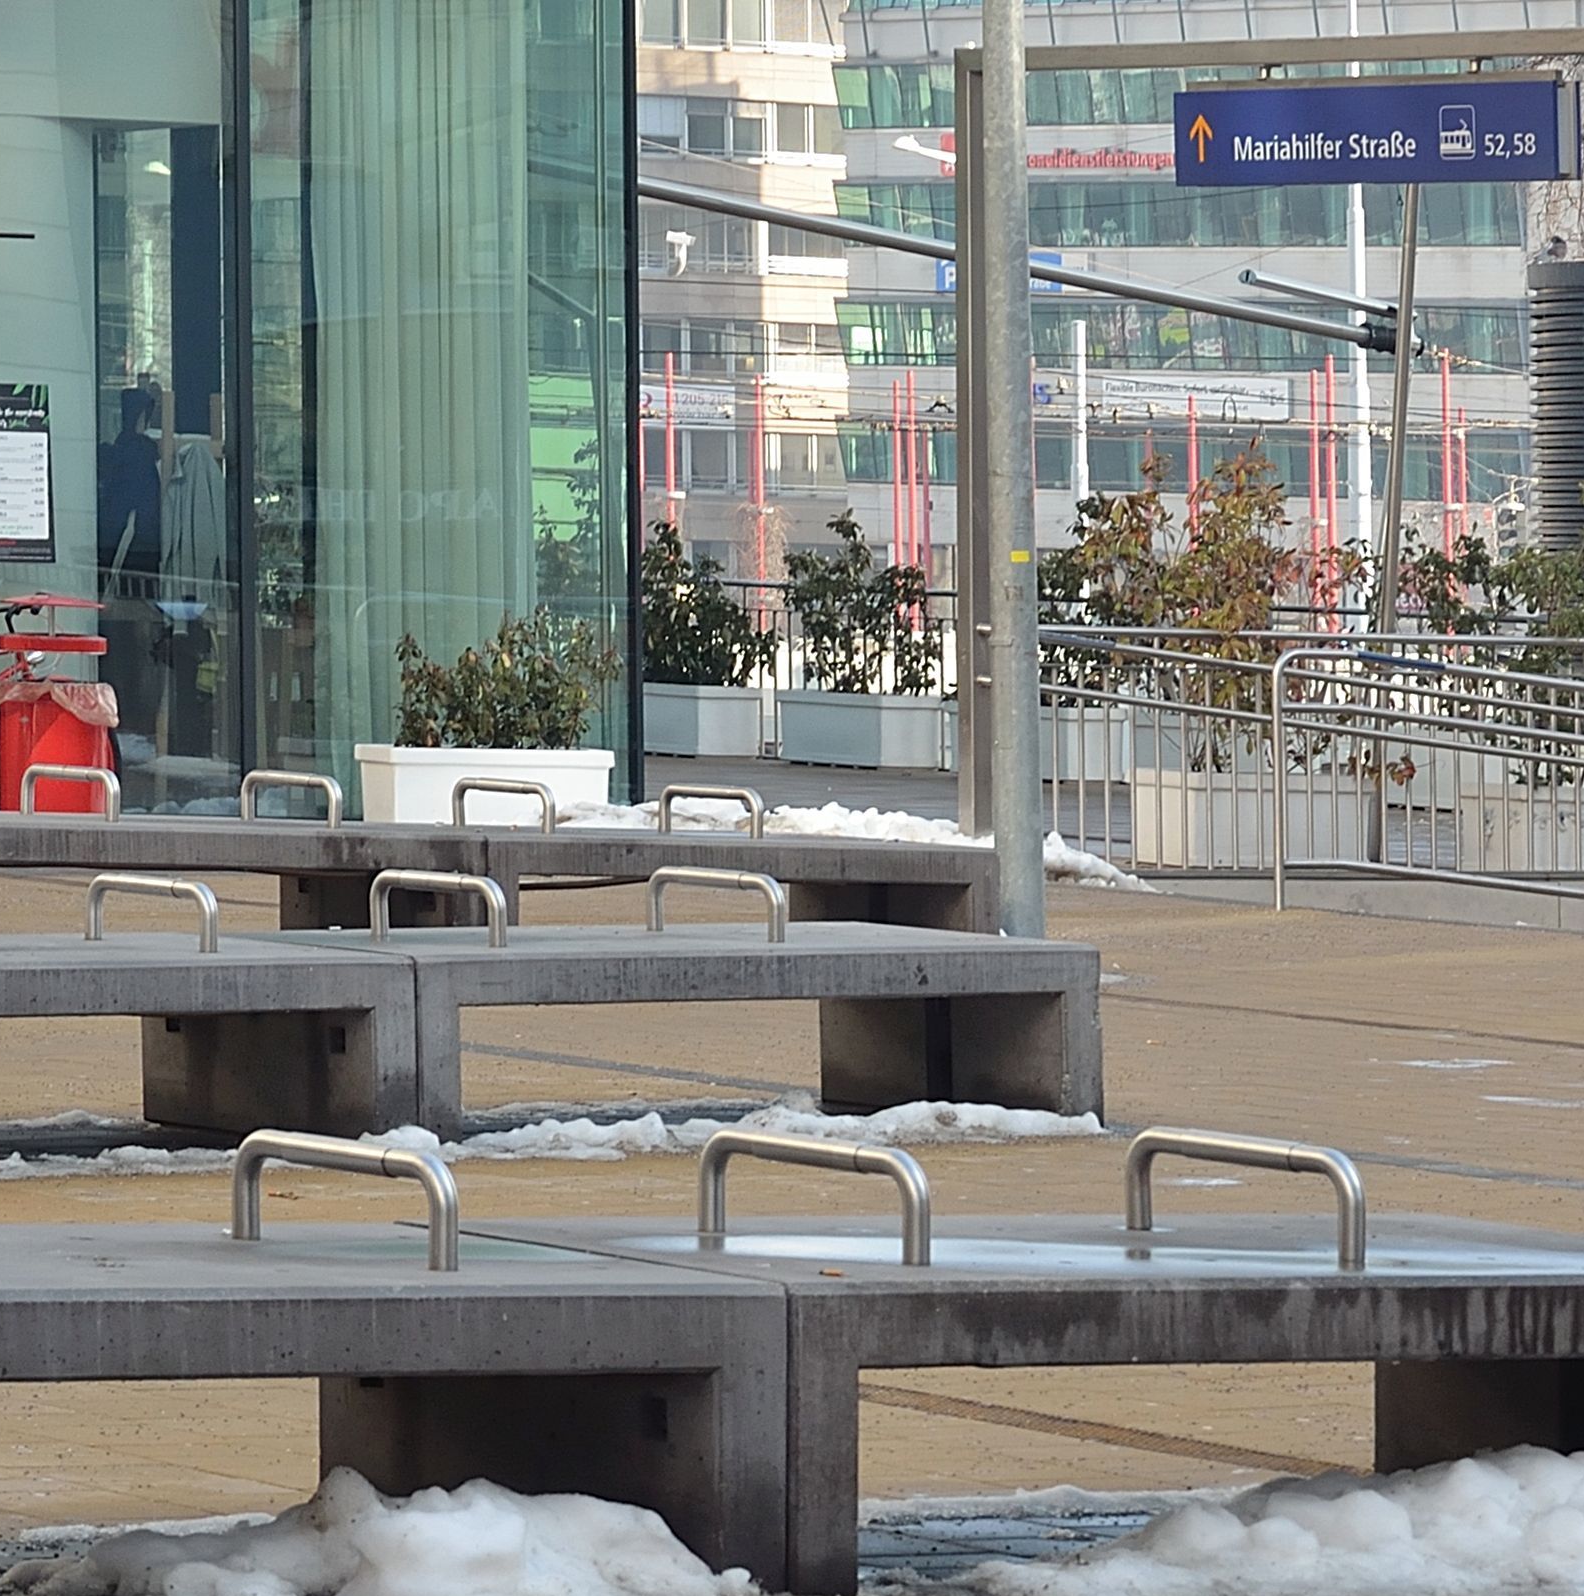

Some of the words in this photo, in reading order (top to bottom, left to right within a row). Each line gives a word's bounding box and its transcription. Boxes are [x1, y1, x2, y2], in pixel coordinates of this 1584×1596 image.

[1233, 132, 1343, 162] Mariahilfer
[1349, 130, 1417, 159] Straße
[1484, 132, 1536, 159] 52,58
[1027, 147, 1174, 171] onaldienstleistungen
[1105, 382, 1134, 393] Flexible
